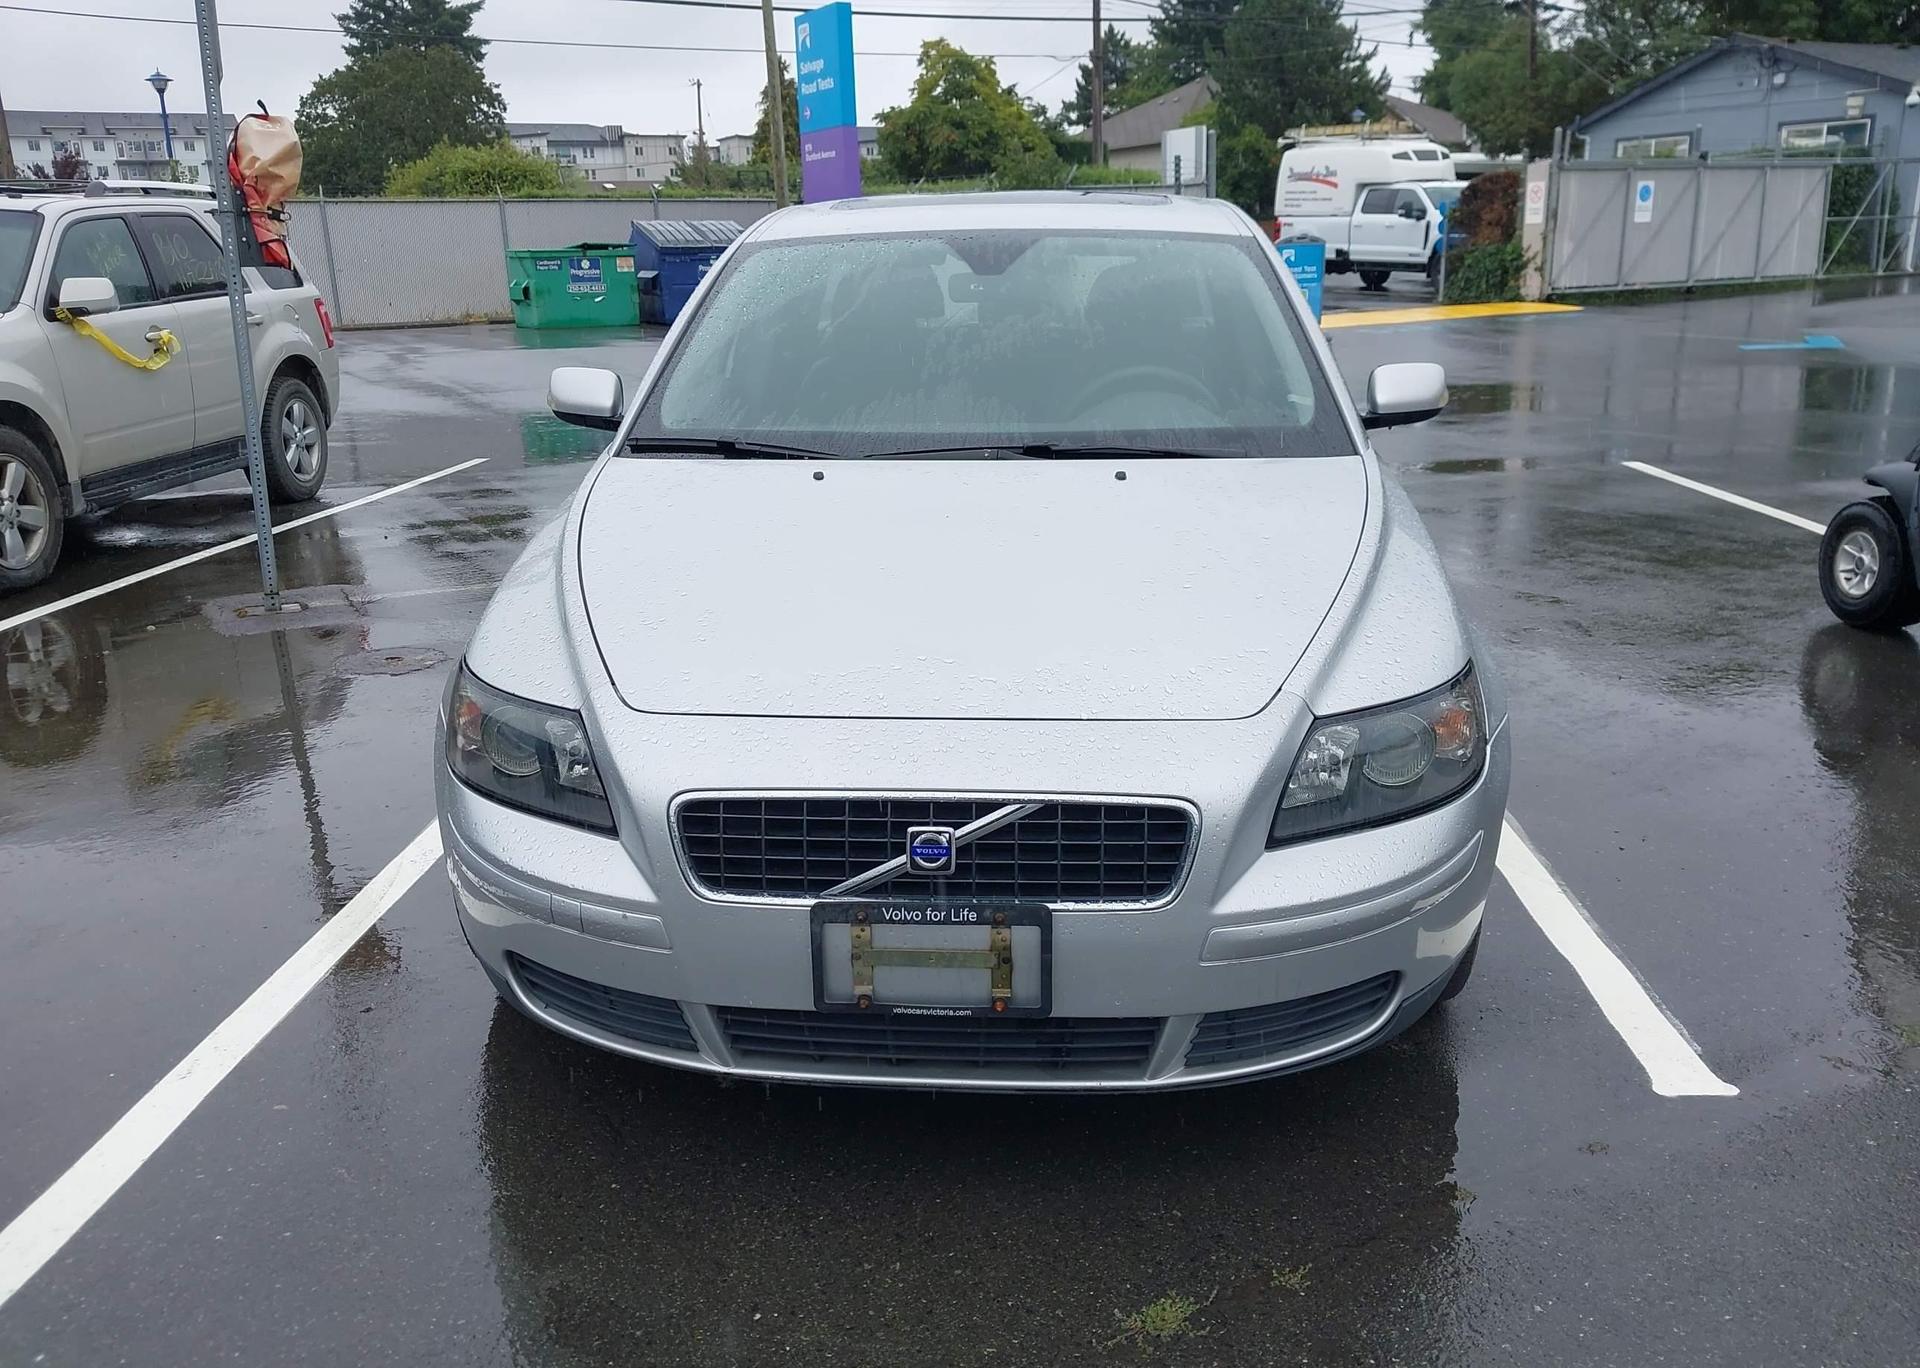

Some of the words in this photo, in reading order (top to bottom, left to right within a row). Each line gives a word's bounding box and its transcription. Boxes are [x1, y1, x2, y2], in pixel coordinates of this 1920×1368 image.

[800, 58, 824, 75] Salvage
[801, 81, 817, 95] Road
[818, 77, 834, 91] Tests
[882, 907, 923, 921] Volvo
[925, 907, 947, 921] for
[951, 907, 977, 922] Life
[892, 1006, 972, 1016] volvocarsvictoria.com
